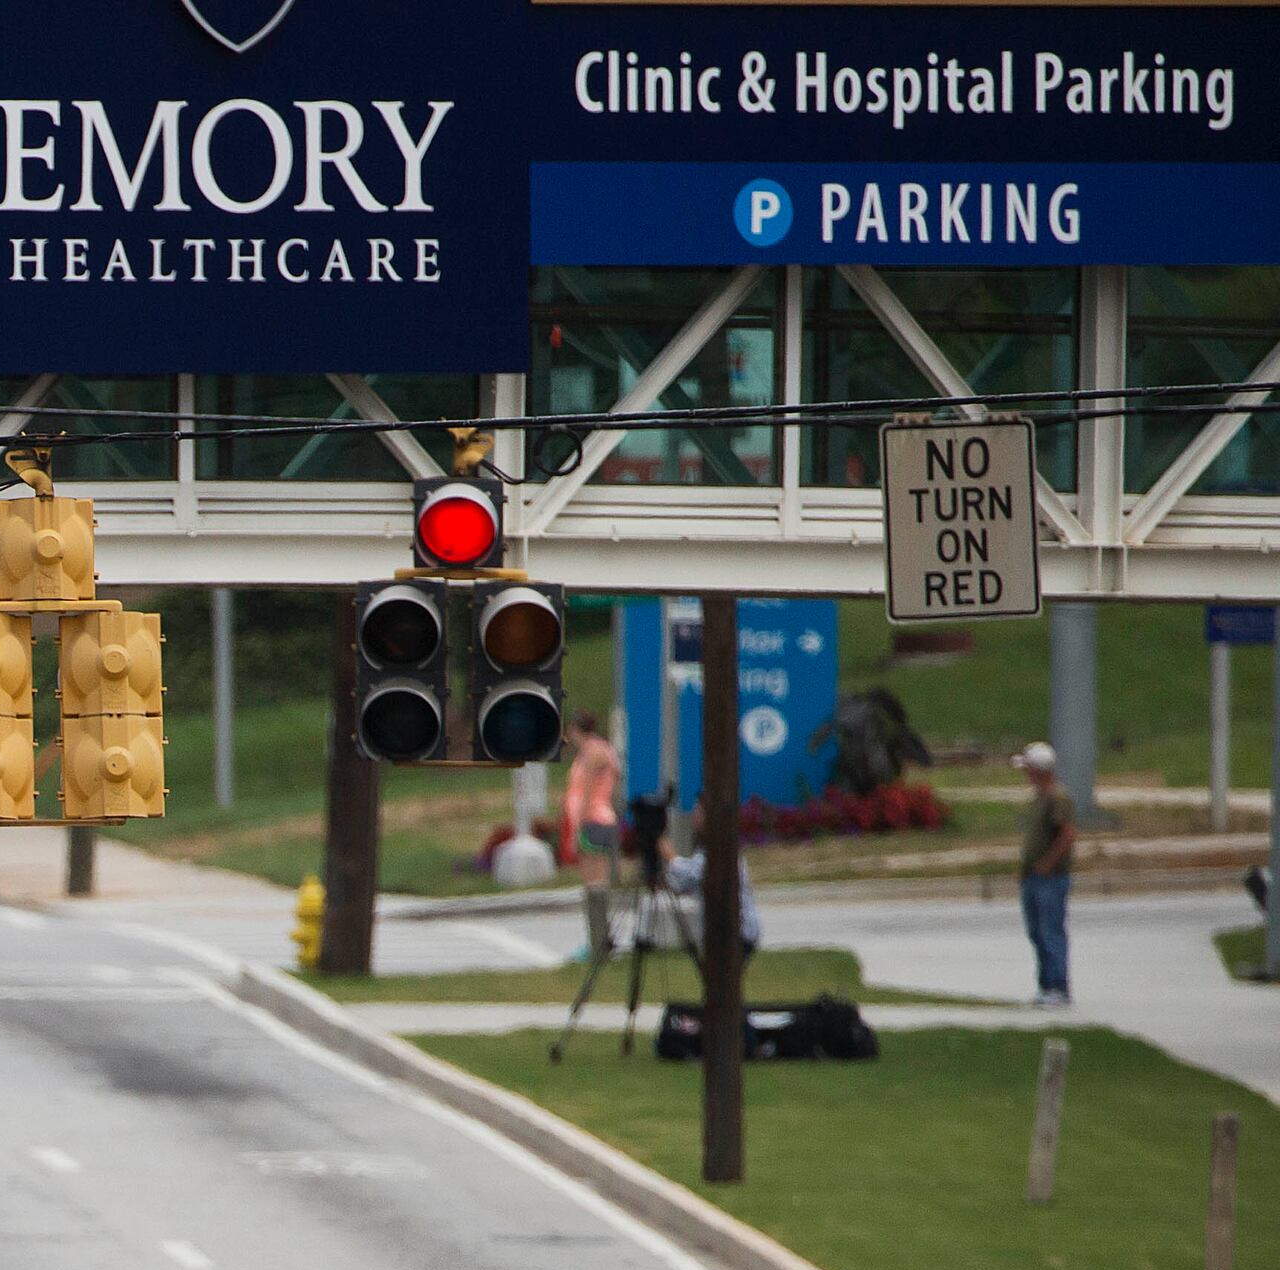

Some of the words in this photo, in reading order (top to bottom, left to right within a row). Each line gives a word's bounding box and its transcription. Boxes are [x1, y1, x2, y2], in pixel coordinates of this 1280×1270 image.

[575, 50, 721, 113] Clinic
[737, 51, 776, 113] &
[796, 50, 1013, 130] Hospital
[1035, 51, 1233, 130] Parking
[822, 182, 1080, 244] PARKING
[9, 238, 441, 283] HEALTHCARE
[925, 436, 990, 481] NO
[908, 485, 1013, 524] TURN
[936, 527, 989, 564] ON
[924, 569, 1003, 607] RED
